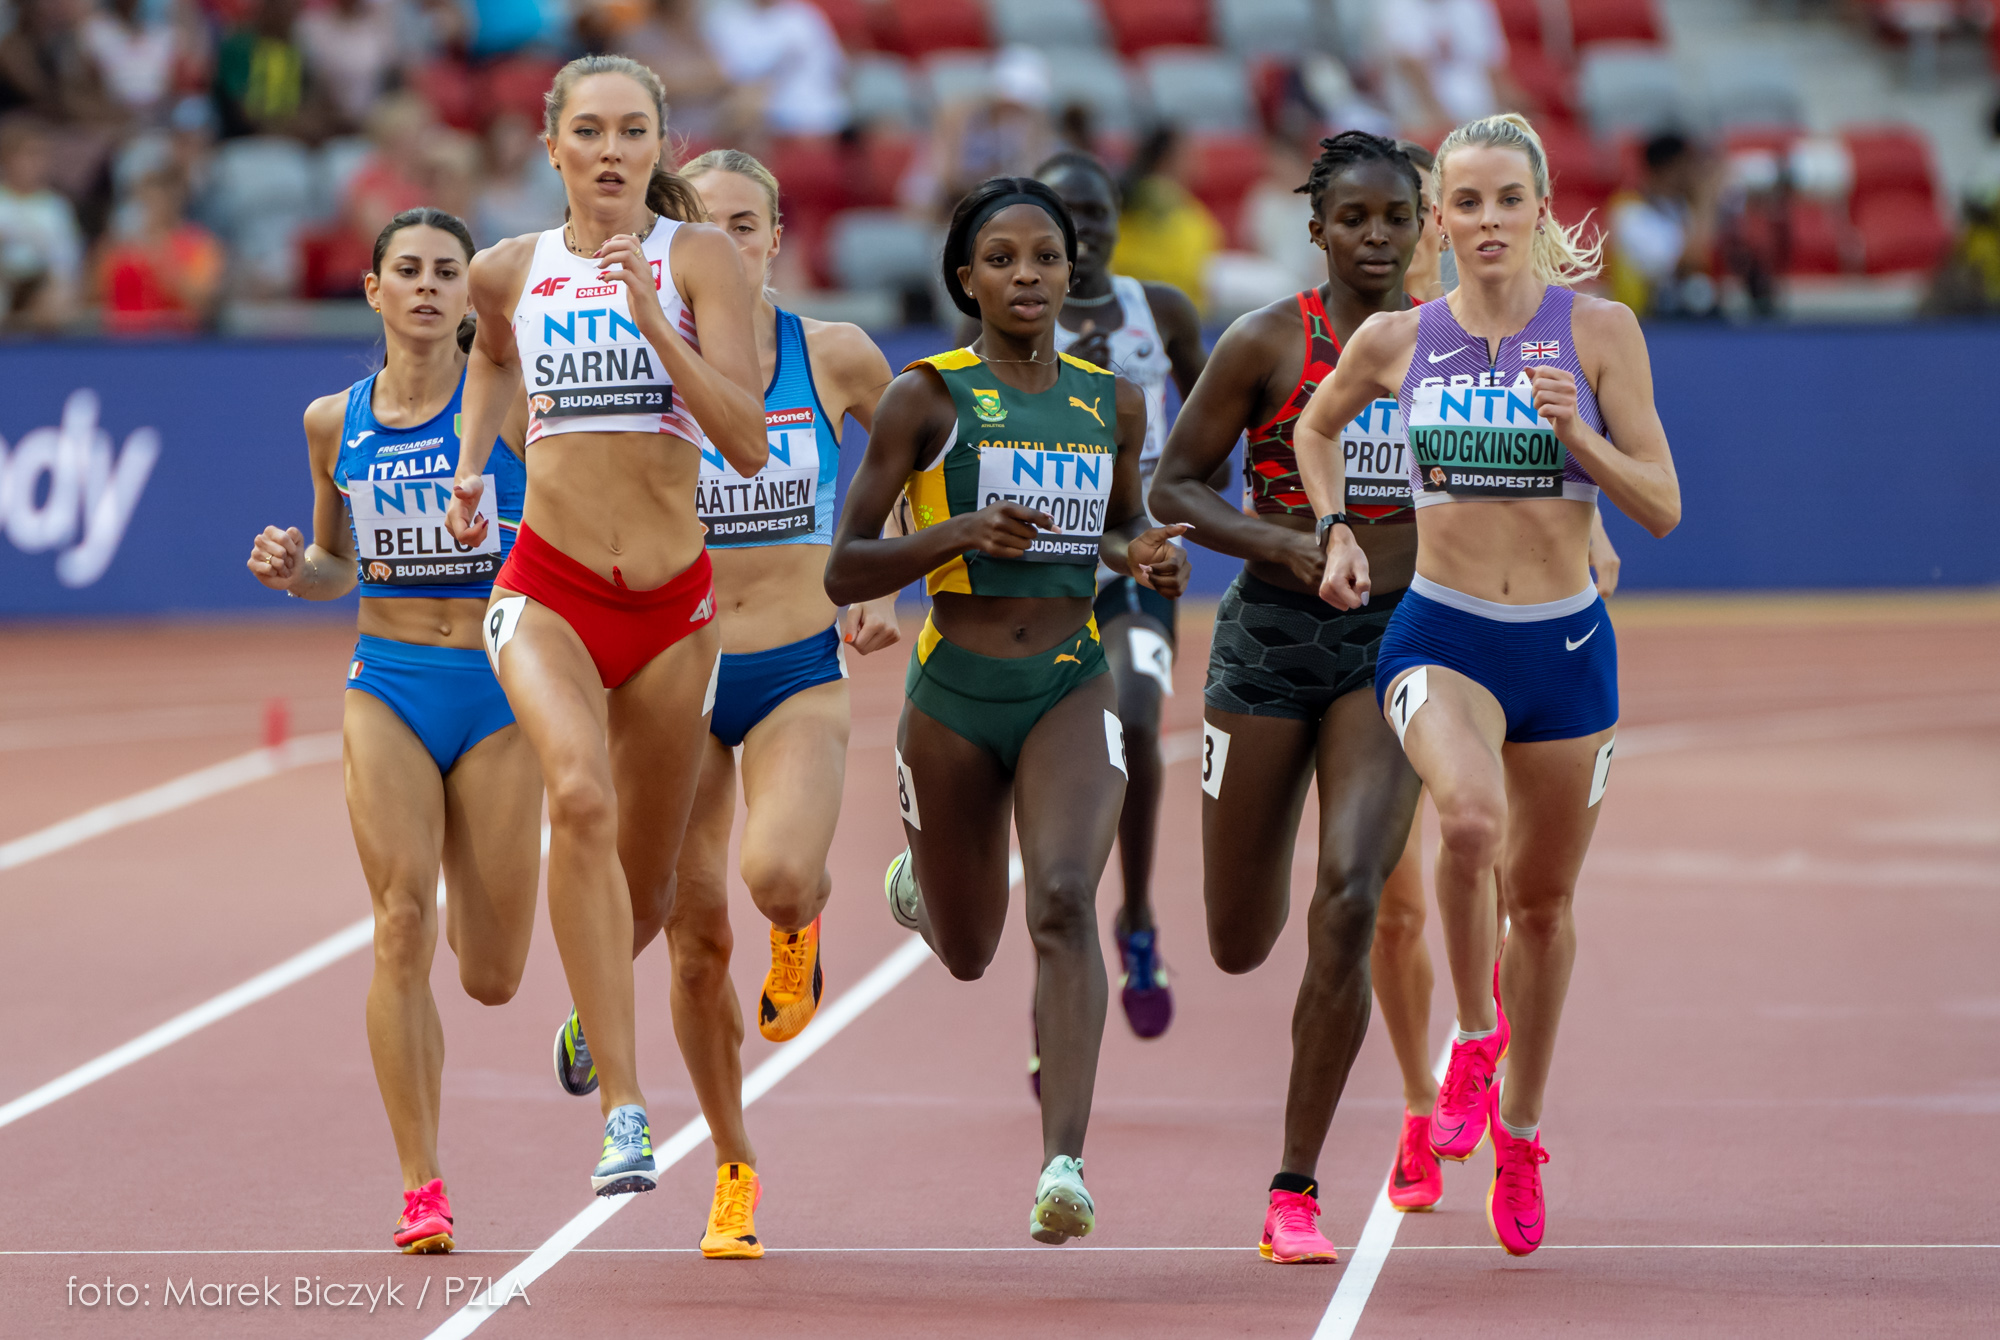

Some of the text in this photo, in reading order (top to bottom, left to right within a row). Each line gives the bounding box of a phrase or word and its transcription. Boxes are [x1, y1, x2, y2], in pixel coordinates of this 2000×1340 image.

[577, 285, 615, 298] ORLEN
[544, 308, 641, 347] NTN
[535, 347, 655, 387] SARNA
[559, 392, 663, 409] BUDAPEST 23
[1439, 388, 1538, 426] NTN
[1343, 401, 1404, 436] NT
[376, 436, 445, 455] FRECCIAROSSA
[1343, 440, 1409, 475] PROT
[1415, 429, 1560, 466] HODGKINSON
[367, 453, 452, 482] ITALIA
[1012, 449, 1101, 492] NTN
[1450, 472, 1555, 489] BUDAPEST 23
[0, 386, 162, 585] dy
[374, 526, 474, 557] BELL
[713, 513, 809, 536] BUDAPEST 23
[395, 560, 494, 577] BUDAPEST 23
[490, 608, 505, 653] 9
[1203, 734, 1214, 782] 3
[898, 765, 911, 813] 8
